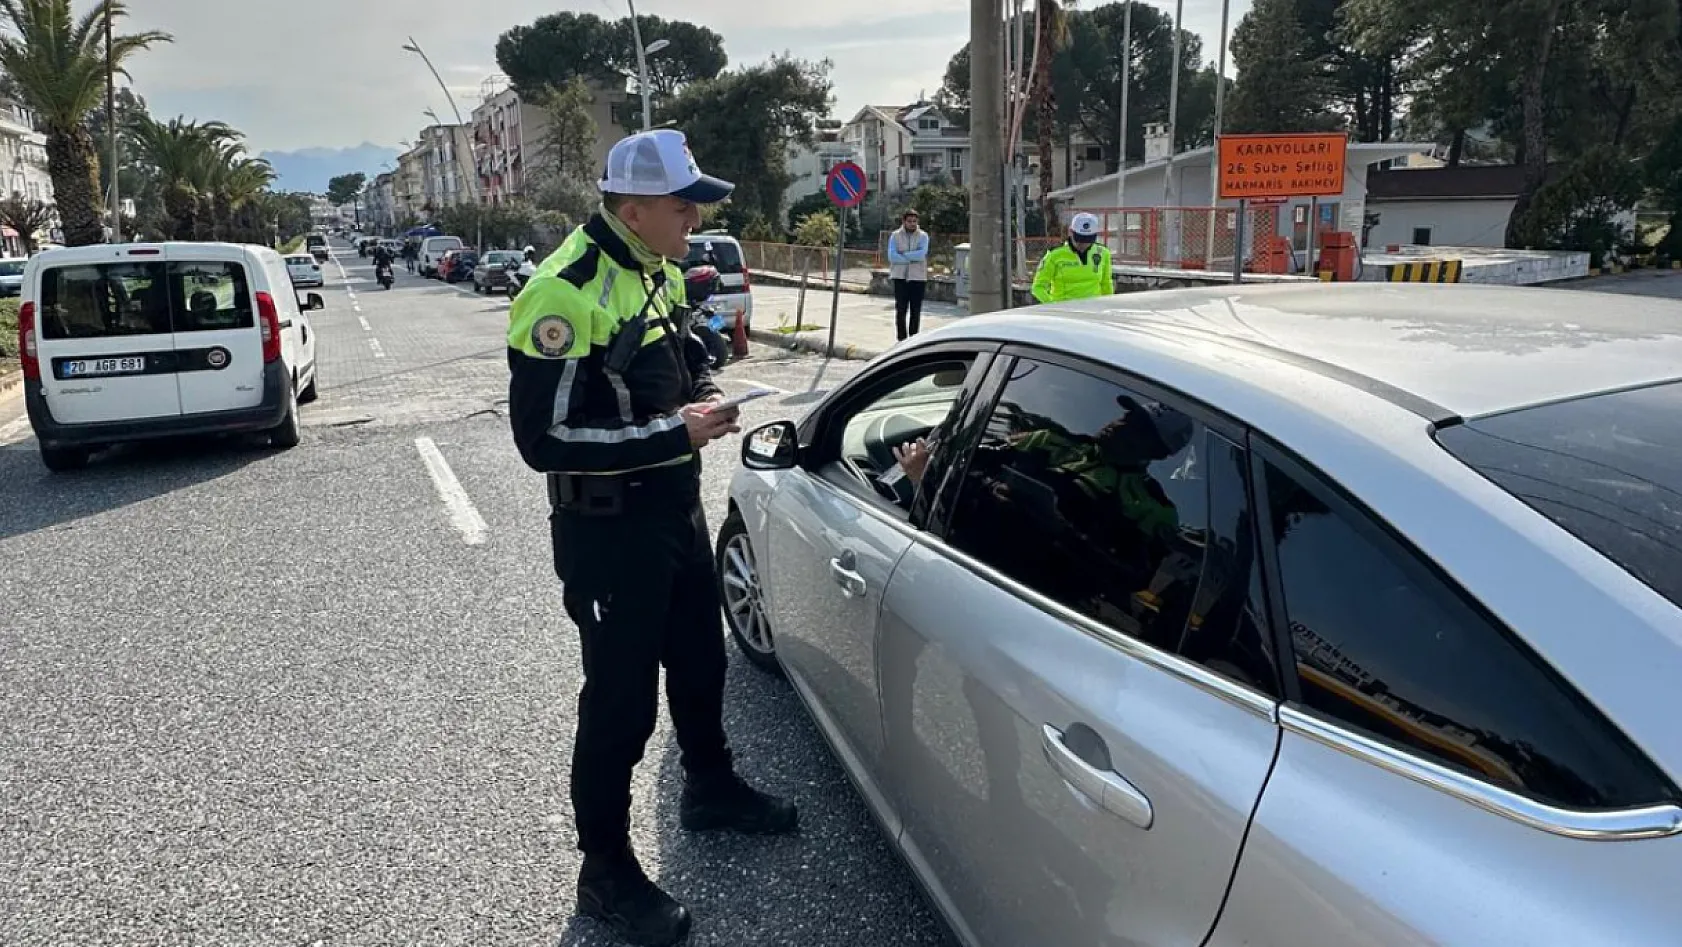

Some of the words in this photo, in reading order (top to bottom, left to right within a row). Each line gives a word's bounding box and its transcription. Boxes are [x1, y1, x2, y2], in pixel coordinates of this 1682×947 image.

[1236, 142, 1331, 156] KARAYOLLARI
[71, 361, 86, 373] 20
[95, 359, 116, 371] AGB
[121, 358, 142, 371] 681
